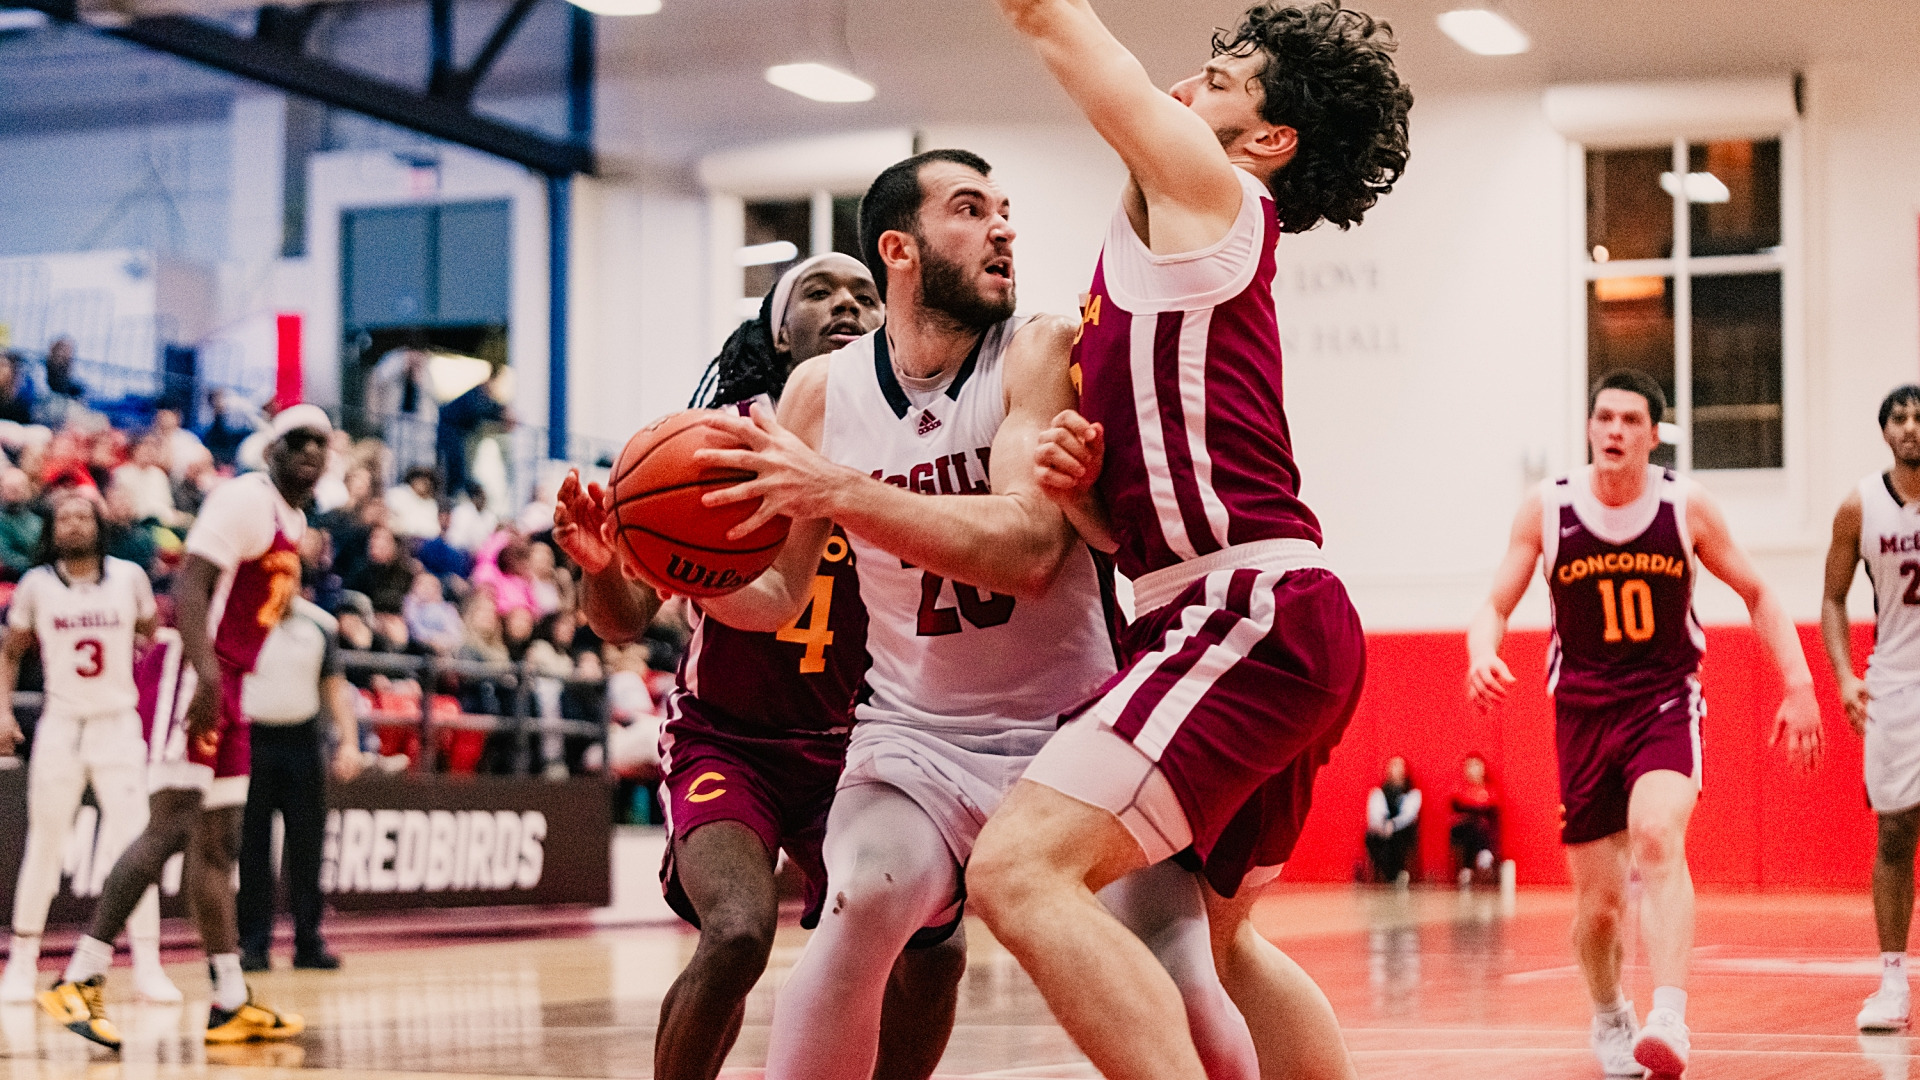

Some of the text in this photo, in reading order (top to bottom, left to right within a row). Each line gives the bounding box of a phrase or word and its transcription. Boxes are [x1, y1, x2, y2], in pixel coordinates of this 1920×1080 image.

[1311, 323, 1401, 354] HALL
[918, 419, 942, 435] adidas
[1558, 552, 1684, 584] CONCORDIA
[776, 575, 834, 673] 4
[1598, 578, 1655, 642] 10
[75, 638, 104, 677] 3
[337, 808, 548, 892] REDBIRDS
